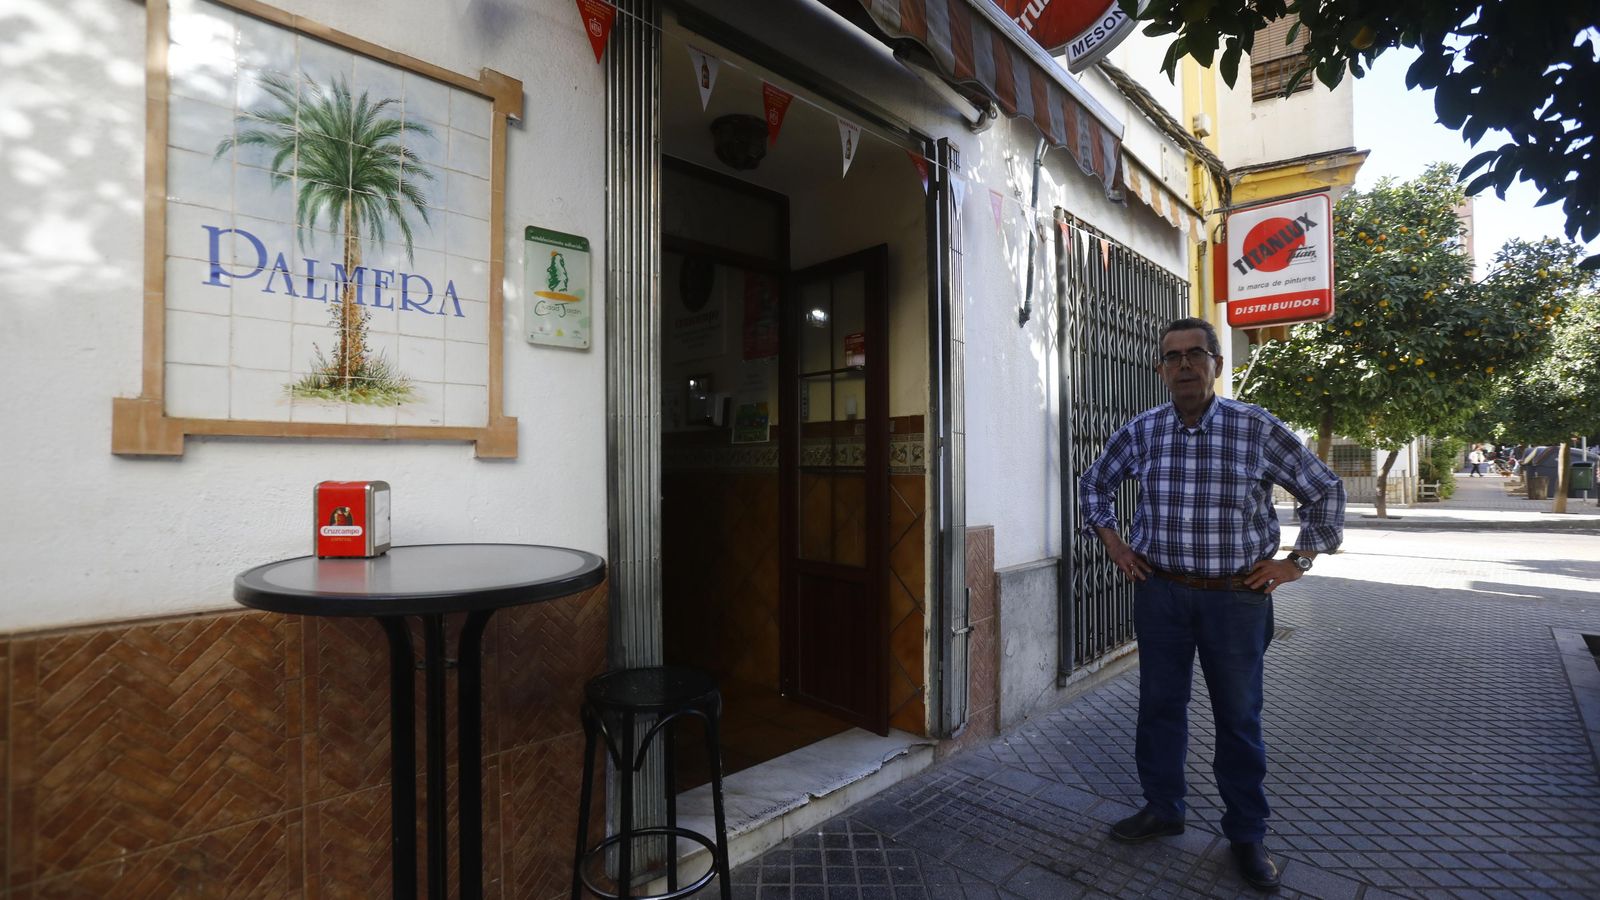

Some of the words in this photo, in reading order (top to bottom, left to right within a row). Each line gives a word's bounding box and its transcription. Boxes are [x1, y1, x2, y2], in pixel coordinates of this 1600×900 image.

[1072, 6, 1126, 57] MESON
[1233, 212, 1318, 275] TITANLUX
[201, 224, 466, 318] PALMERA
[1247, 282, 1269, 290] marca
[1284, 276, 1316, 286] pinturas
[1235, 298, 1320, 315] DISTRIBUIDOR
[323, 527, 360, 535] Cruzcampo
